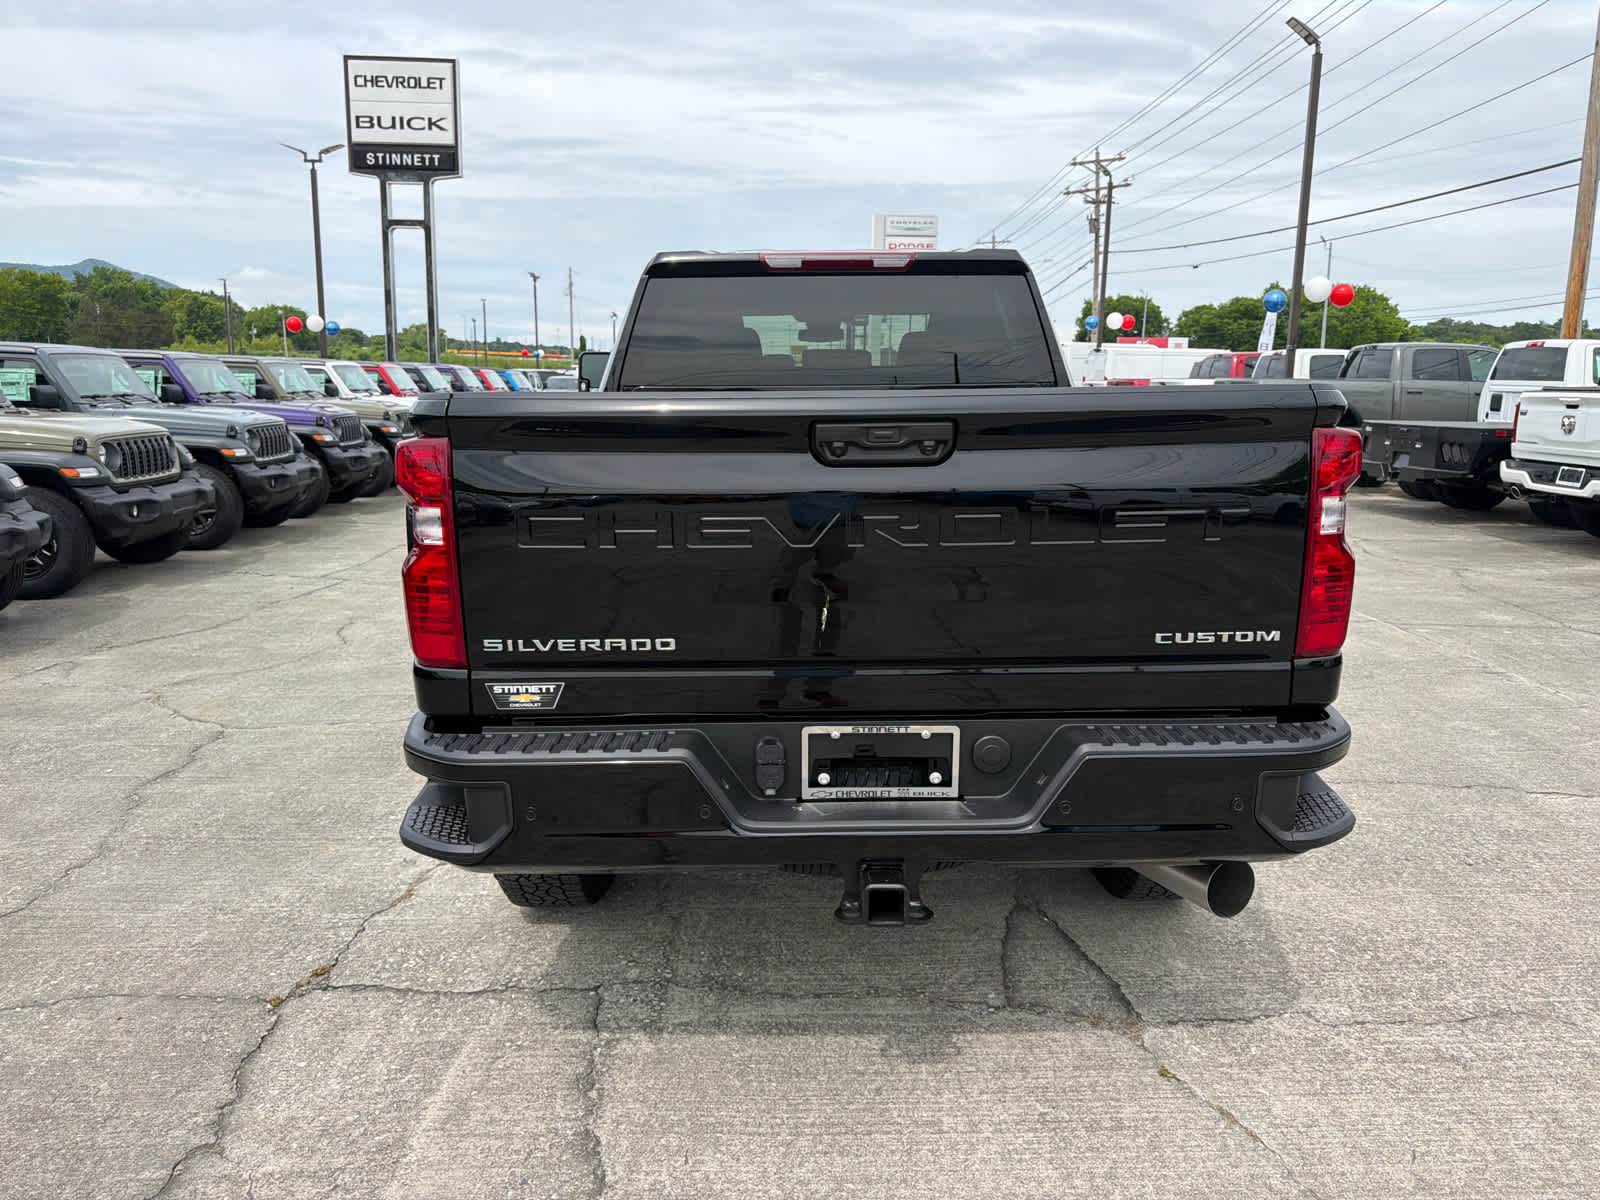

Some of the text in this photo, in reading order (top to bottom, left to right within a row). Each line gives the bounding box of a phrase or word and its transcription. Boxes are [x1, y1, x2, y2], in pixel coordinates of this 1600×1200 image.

[353, 74, 446, 90] CHEVROLET
[354, 115, 449, 132] BUICK
[366, 152, 441, 166] STINNETT
[515, 507, 1251, 548] CHEVROLET
[1154, 630, 1281, 645] CUSTOM
[482, 638, 677, 652] SILVERADO
[492, 684, 557, 694] STINNETT
[851, 726, 911, 734] STINNETT
[835, 790, 892, 798] CHEVROLET
